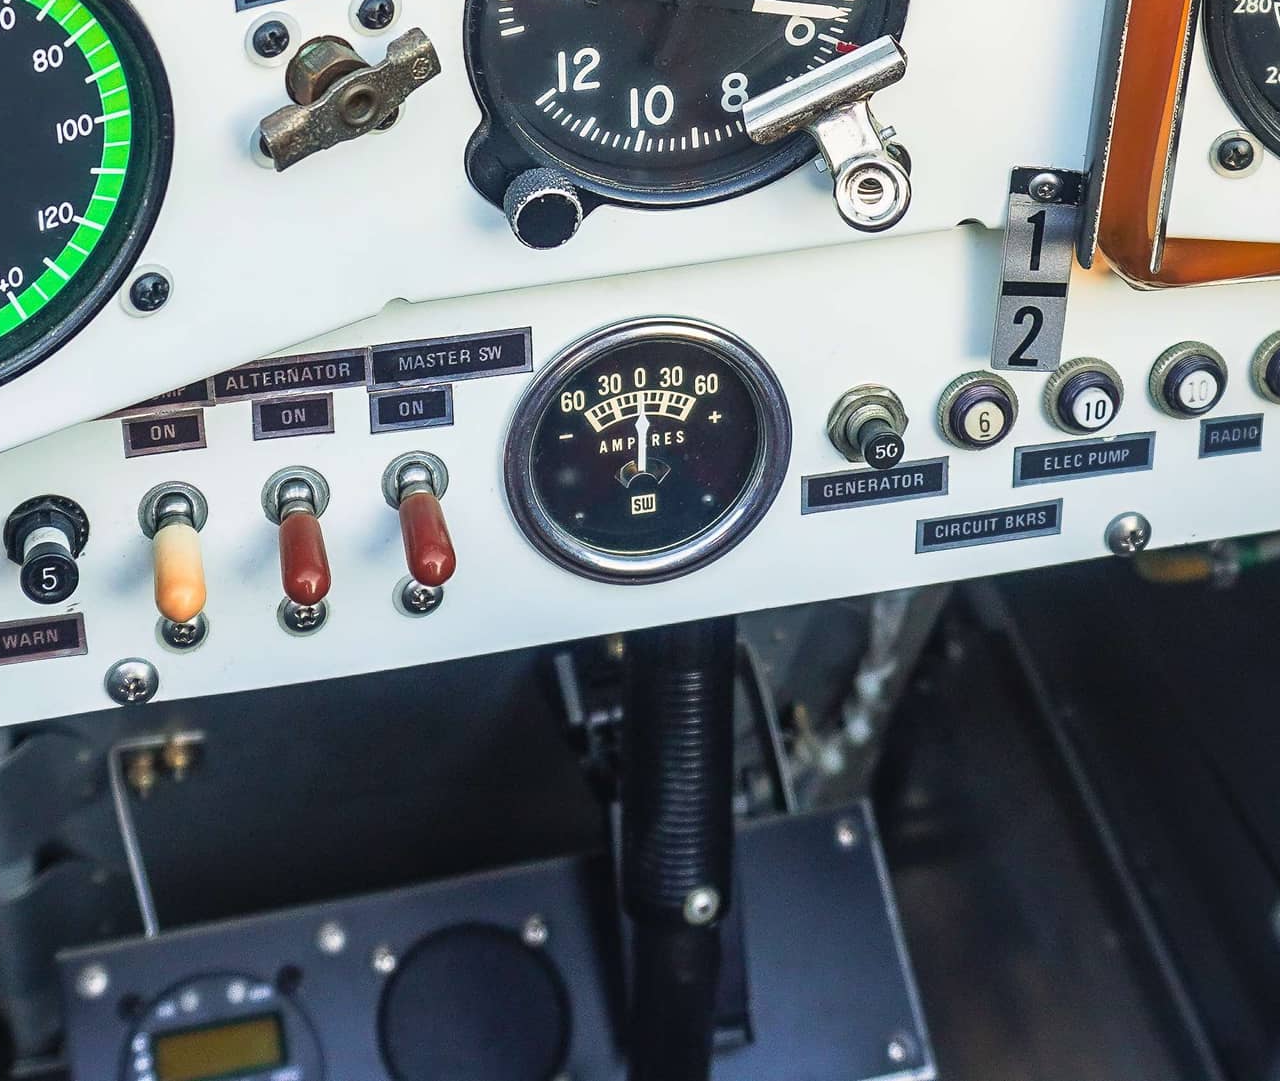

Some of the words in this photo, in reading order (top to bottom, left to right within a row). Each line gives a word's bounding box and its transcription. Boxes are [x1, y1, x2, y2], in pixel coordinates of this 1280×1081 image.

[32, 45, 64, 73] 80
[558, 47, 601, 93] 12
[630, 85, 674, 129] 10
[56, 115, 93, 144] 100
[38, 203, 74, 231] 120
[1027, 210, 1046, 270] 1
[1008, 306, 1043, 367] 2
[398, 350, 471, 371] MASTER
[479, 346, 503, 361] SW
[226, 362, 350, 391] ALTERNATOR
[598, 373, 622, 396] 30
[660, 366, 683, 388] 30
[694, 373, 718, 395] 60
[399, 400, 424, 416] ON
[561, 390, 585, 413] 60
[1084, 399, 1107, 421] 10
[281, 409, 306, 424] ON
[150, 426, 176, 441] ON
[599, 430, 685, 454] AMPRES
[1210, 426, 1258, 444] RADIO
[875, 442, 899, 460] 50
[1043, 453, 1083, 471] ELEC
[1088, 448, 1131, 465] PUMP
[823, 473, 925, 499] GENERATOR
[934, 518, 999, 539] CIRCUIT
[1005, 511, 1047, 530] BKRS
[42, 568, 58, 590] 5
[3, 628, 59, 650] WARN
